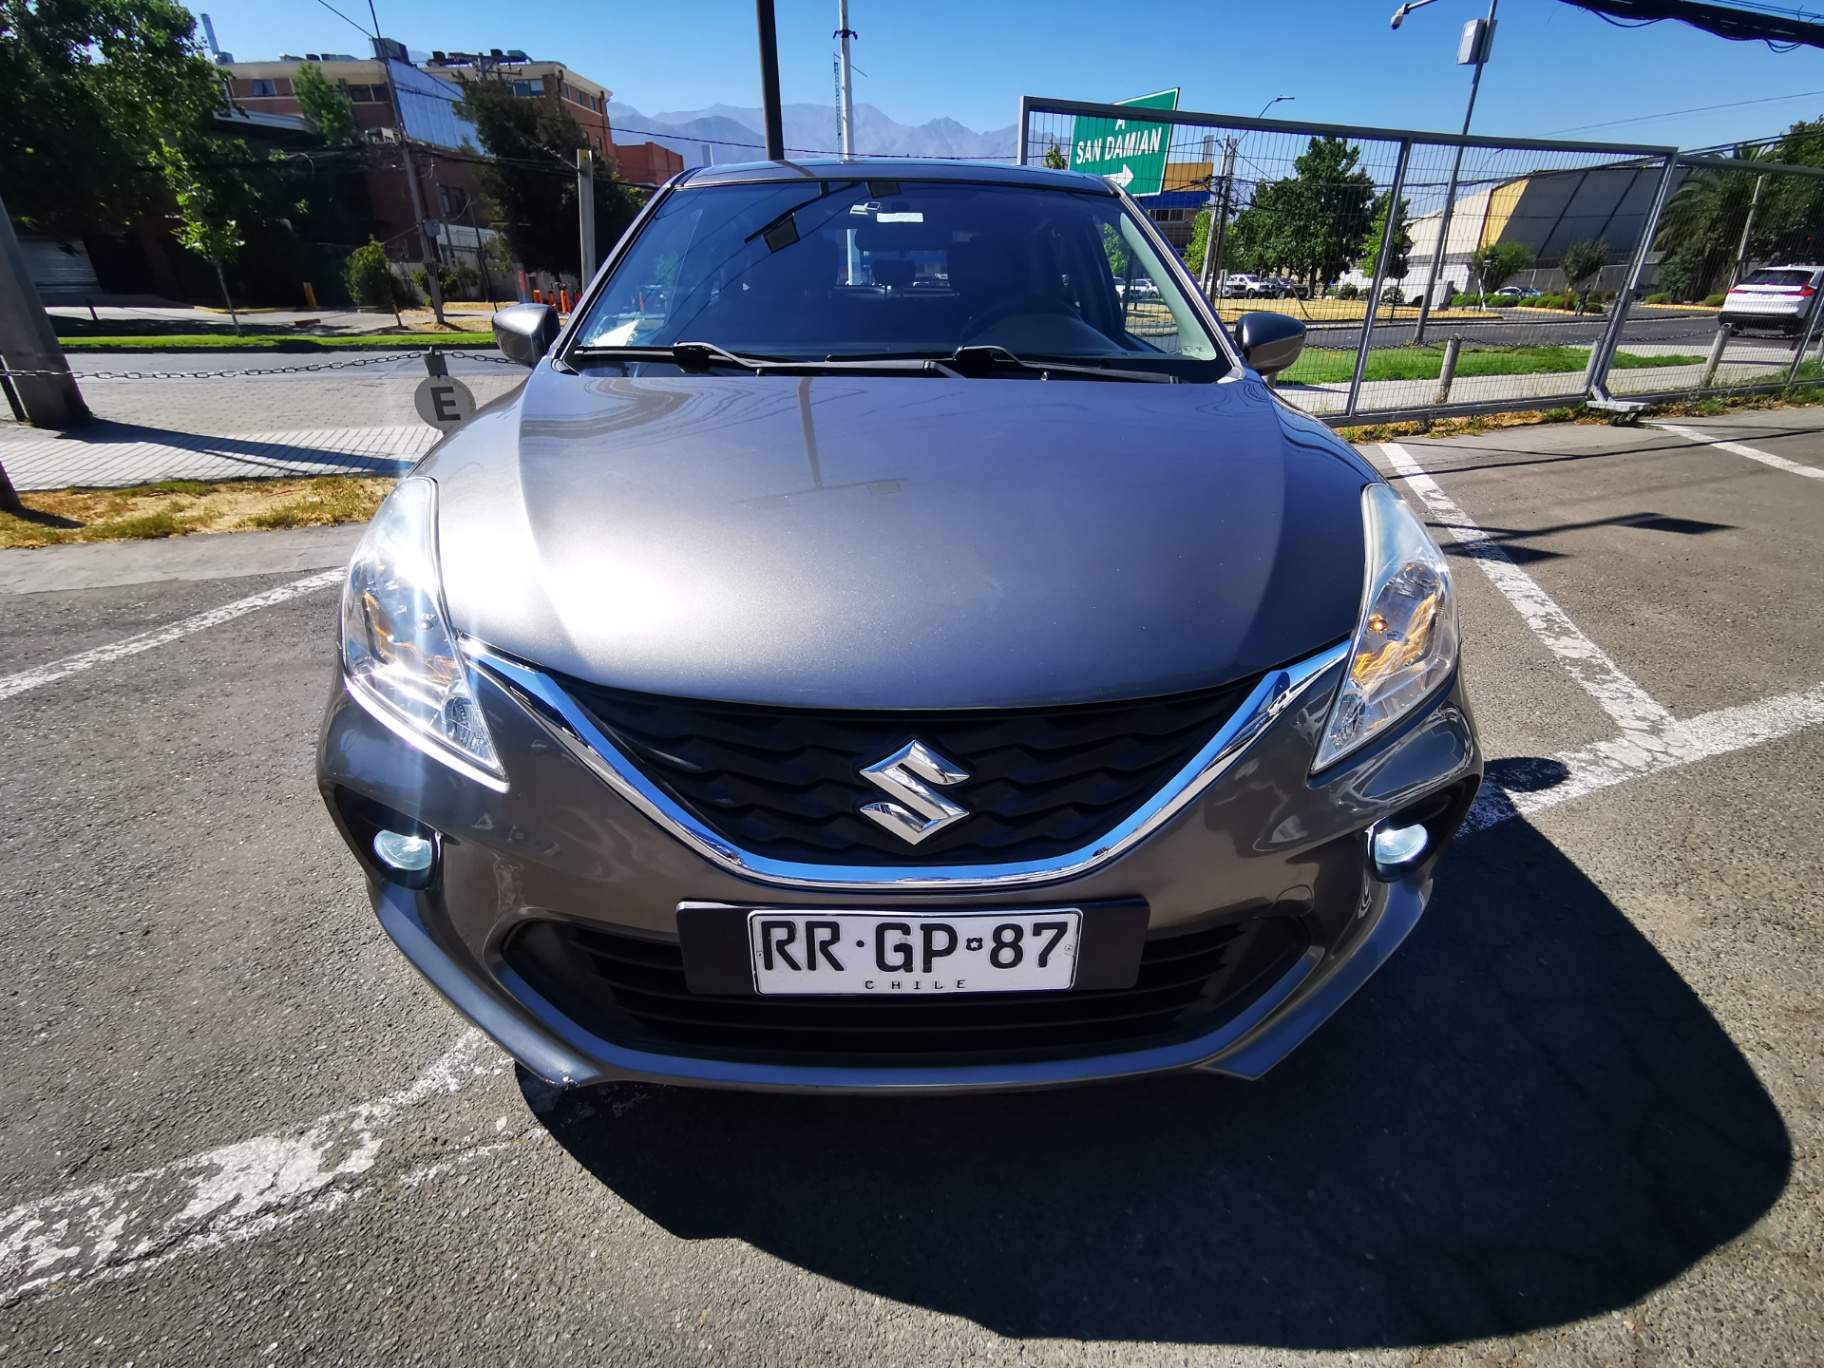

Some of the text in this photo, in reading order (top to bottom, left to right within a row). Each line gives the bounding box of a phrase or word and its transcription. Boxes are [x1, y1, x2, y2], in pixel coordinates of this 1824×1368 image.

[1076, 127, 1162, 164] SAN DAMIAN
[430, 386, 462, 421] E
[864, 979, 967, 990] CHILE
